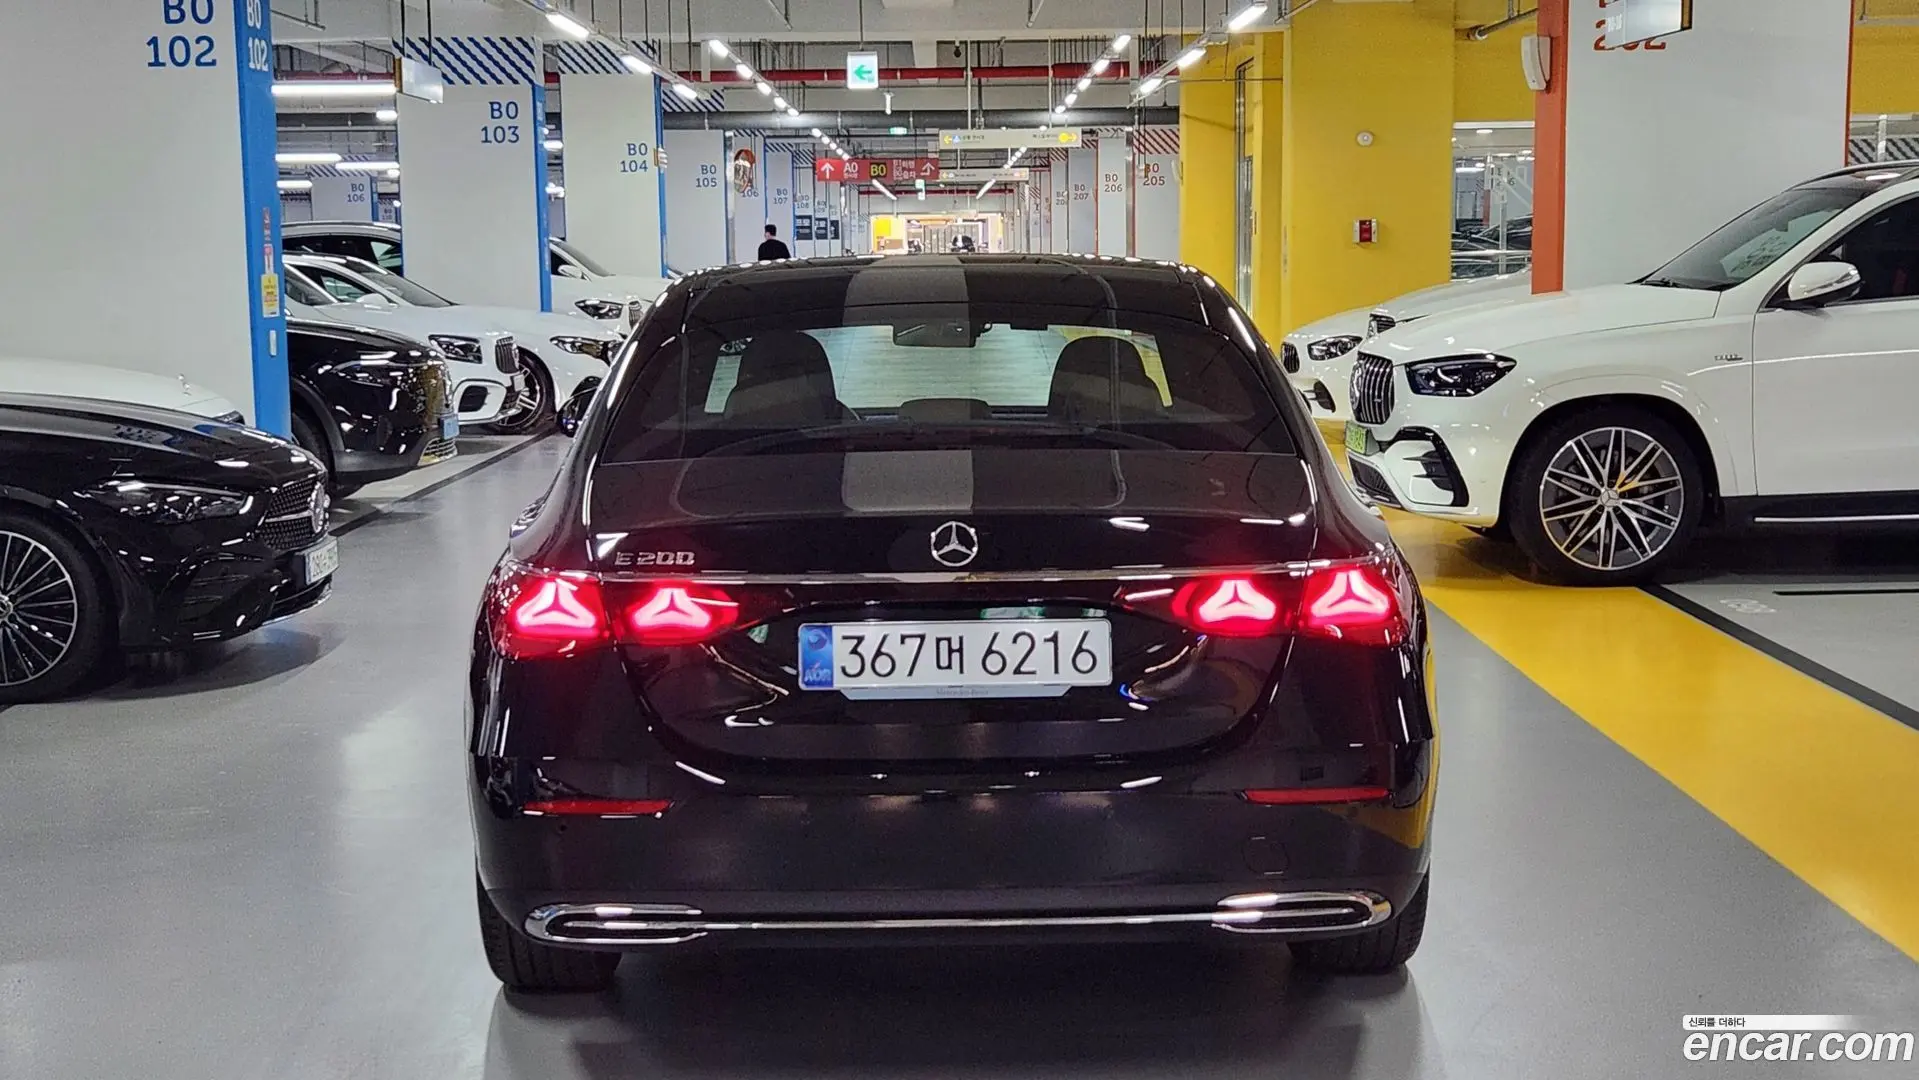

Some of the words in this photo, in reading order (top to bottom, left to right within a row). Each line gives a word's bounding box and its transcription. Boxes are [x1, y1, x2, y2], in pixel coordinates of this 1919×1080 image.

[146, 35, 217, 67] 102
[247, 37, 269, 71] 102
[488, 101, 519, 119] B0
[480, 126, 520, 143] 103
[627, 142, 648, 156] B0
[620, 160, 648, 172] 104
[700, 164, 717, 175] B0
[870, 164, 888, 177] B0
[696, 177, 718, 188] 105
[1143, 176, 1166, 186] 205
[1104, 184, 1123, 192] 206
[347, 194, 366, 203] 106
[773, 197, 788, 205] 107
[614, 551, 634, 566] E
[636, 551, 696, 566] 200
[840, 632, 964, 678] 367머
[980, 629, 1099, 677] 6216
